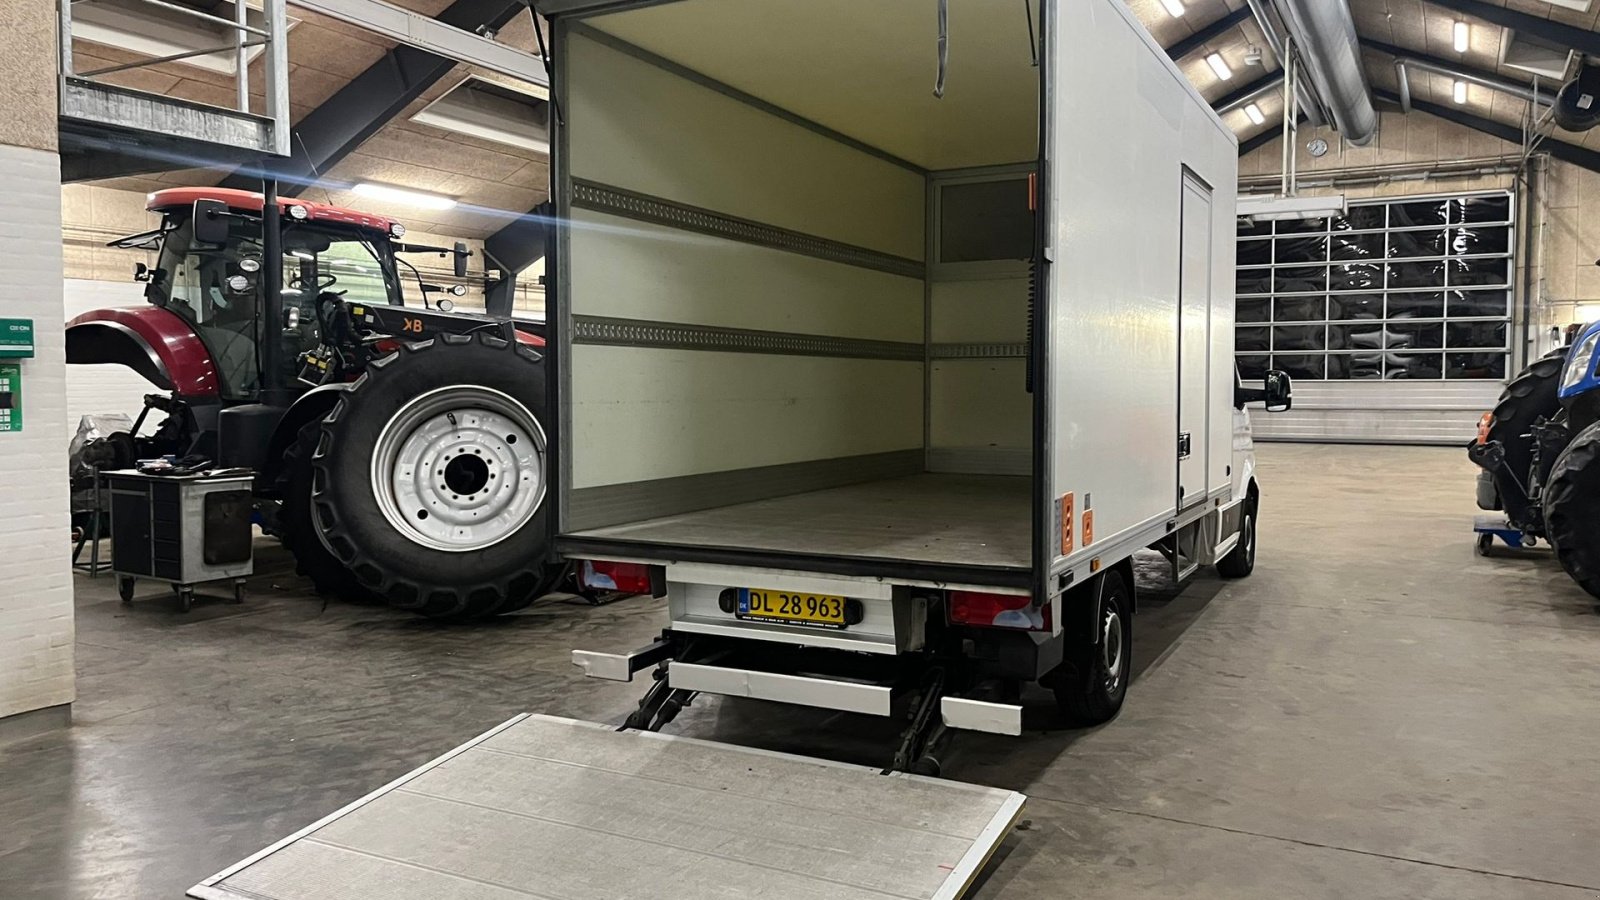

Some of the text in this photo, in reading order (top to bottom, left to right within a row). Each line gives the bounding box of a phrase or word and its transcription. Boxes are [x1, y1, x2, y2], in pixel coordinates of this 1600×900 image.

[750, 592, 841, 618] DL 28 963
